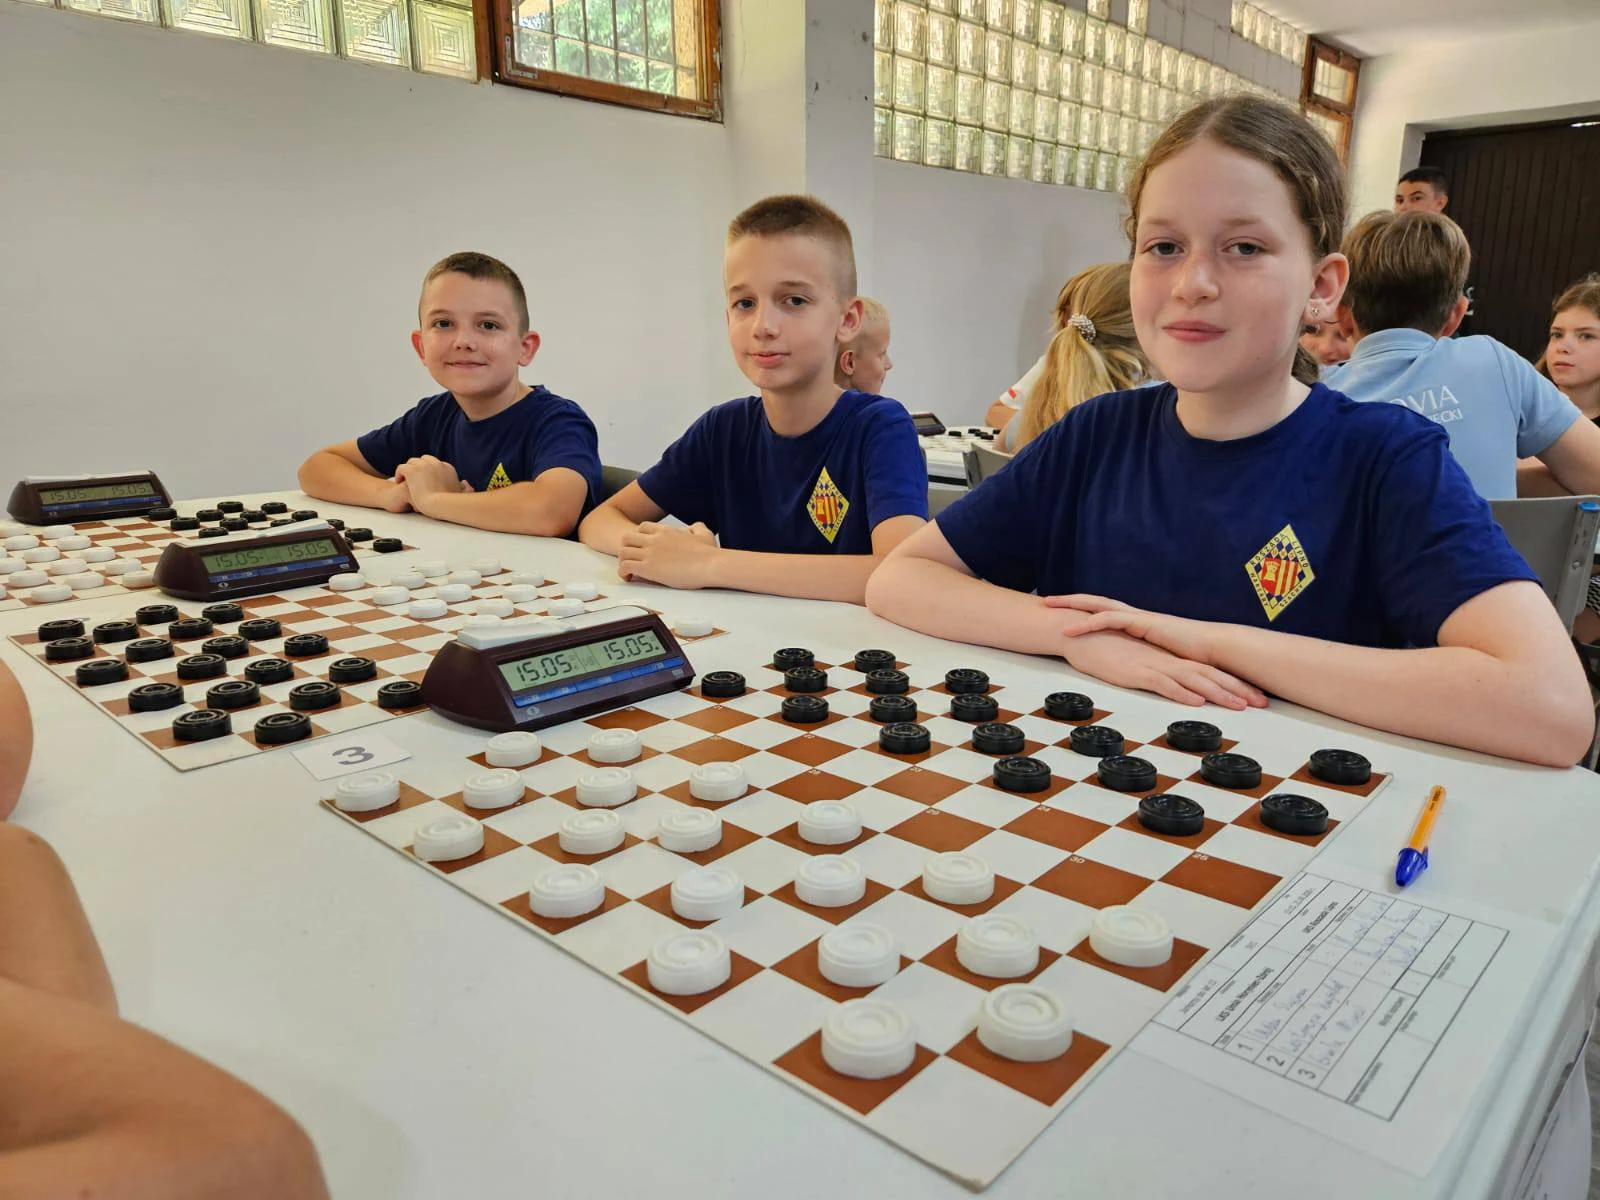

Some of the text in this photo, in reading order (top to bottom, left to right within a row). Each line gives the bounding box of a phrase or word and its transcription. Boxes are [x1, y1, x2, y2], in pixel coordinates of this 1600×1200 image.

[332, 746, 375, 765] 3
[1069, 855, 1086, 864] 30
[1237, 1043, 1254, 1054] 1
[1266, 1055, 1285, 1067] 2
[1298, 1068, 1317, 1079] 3
